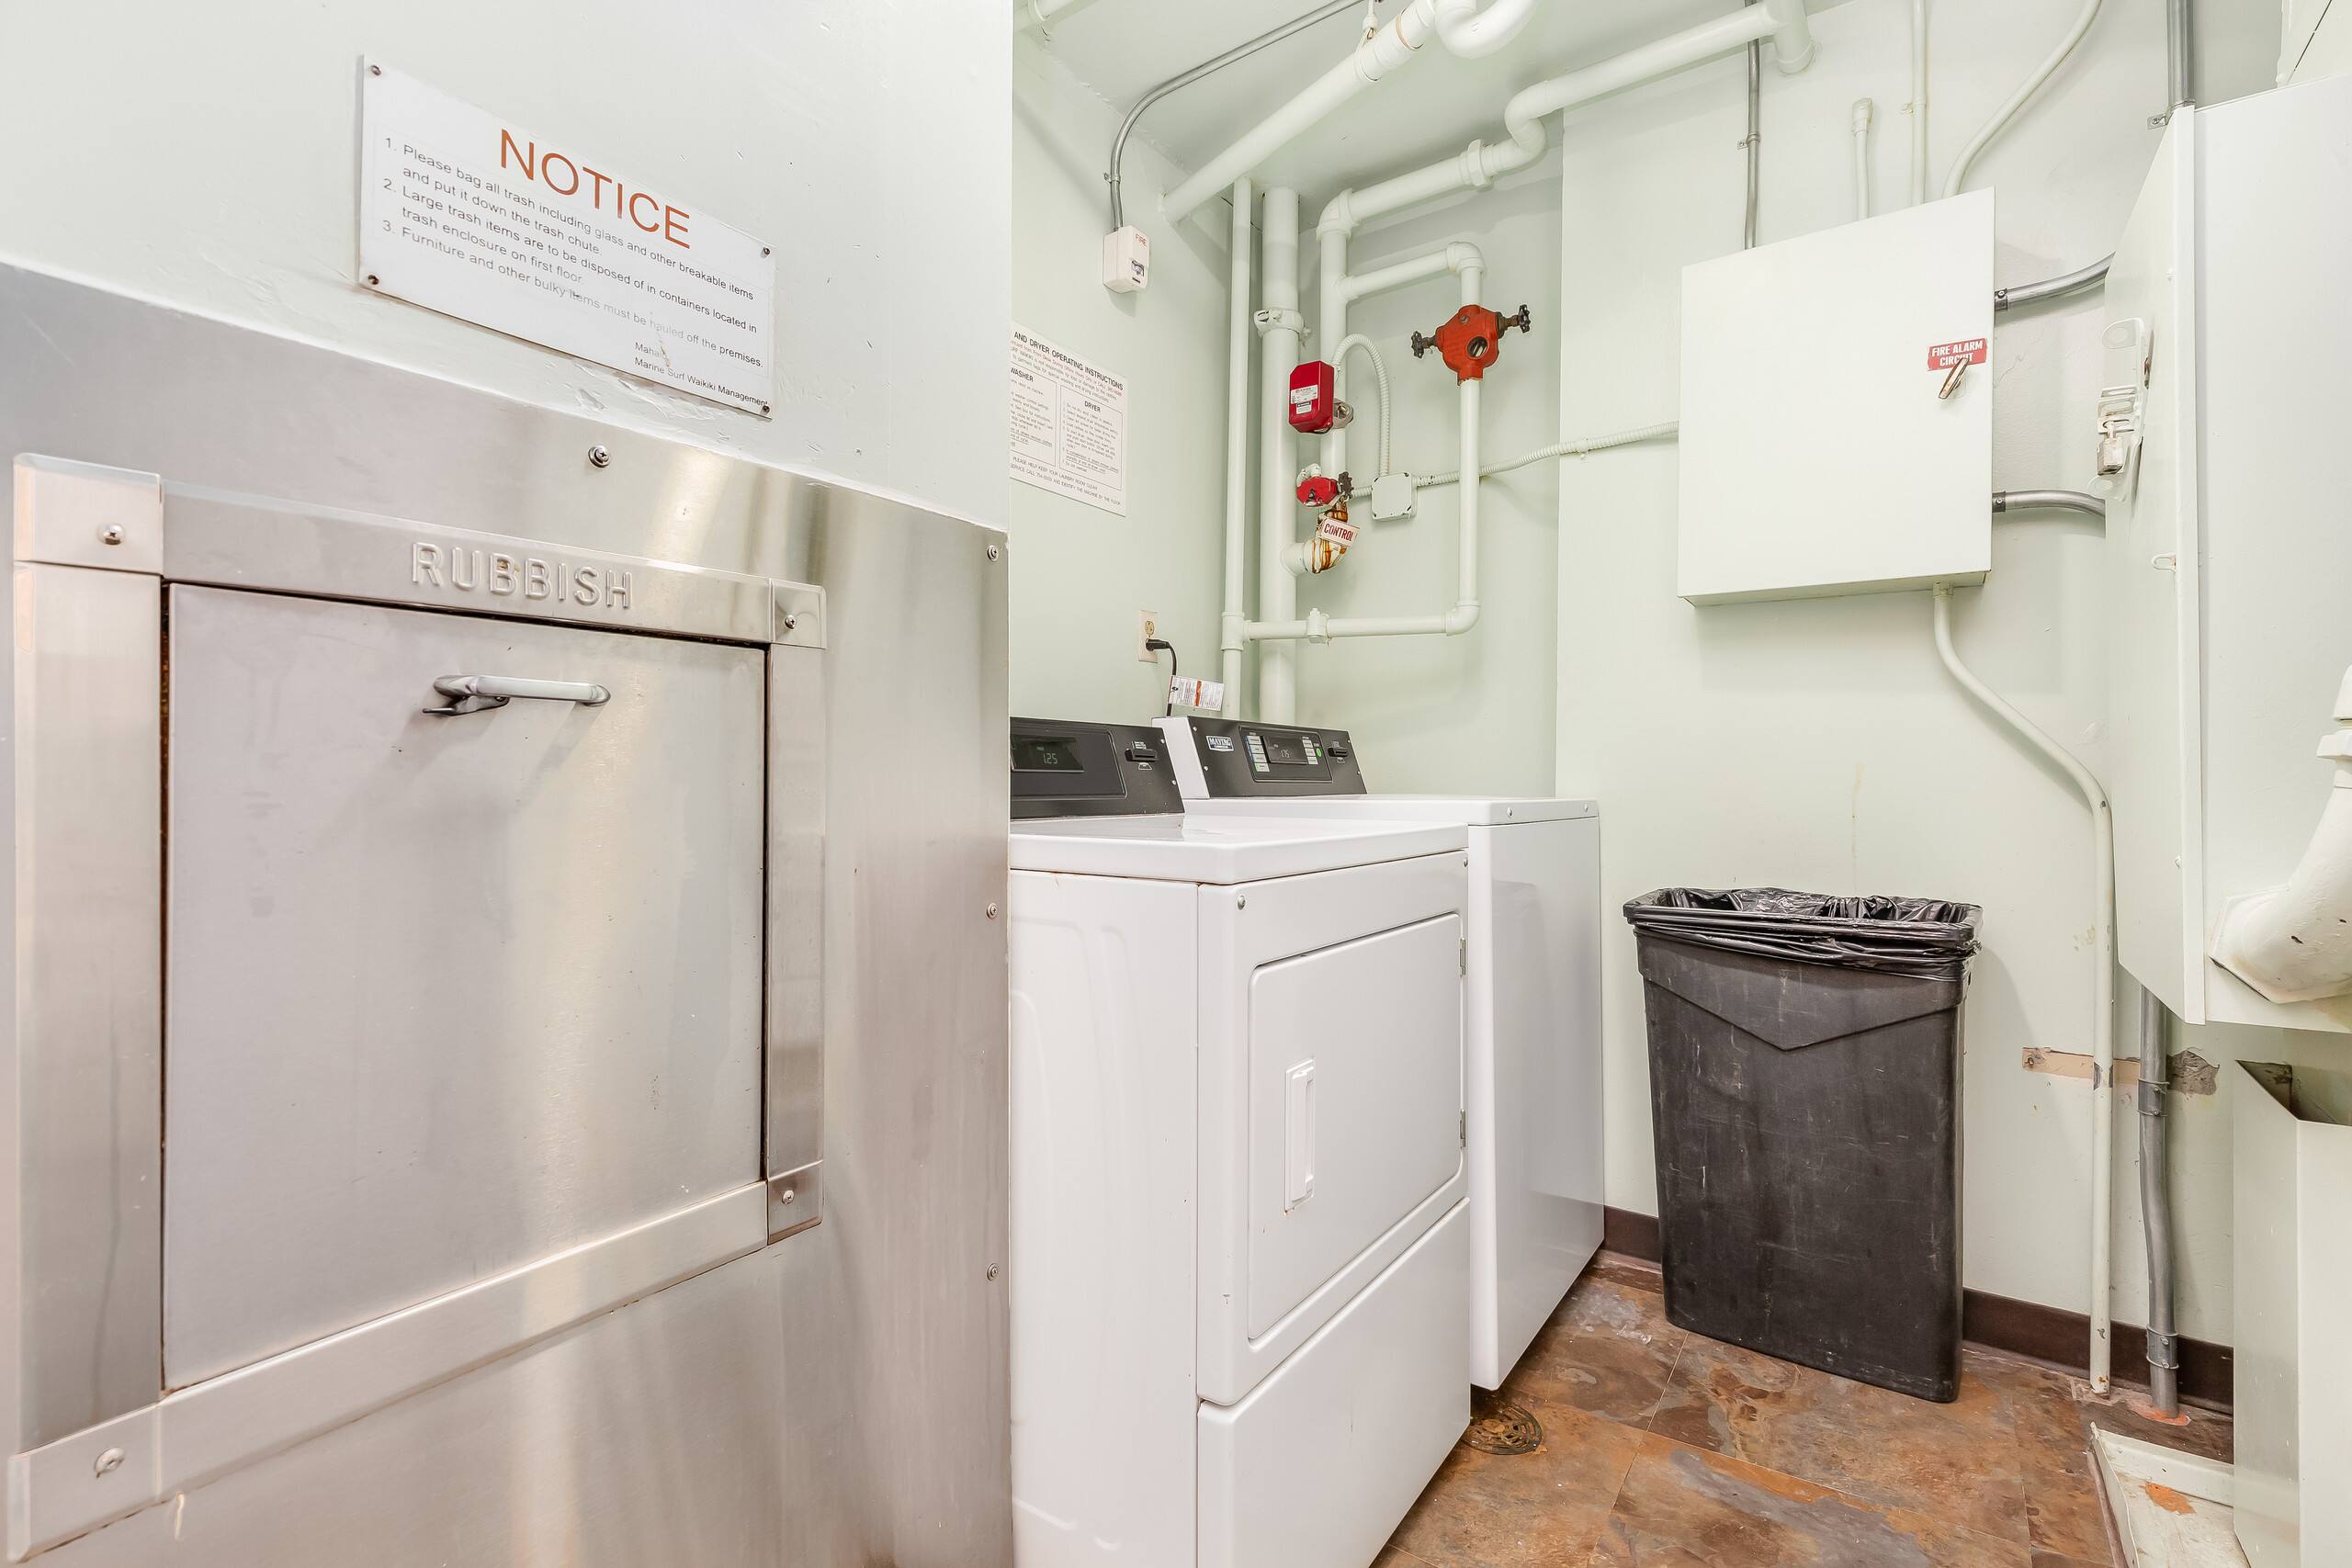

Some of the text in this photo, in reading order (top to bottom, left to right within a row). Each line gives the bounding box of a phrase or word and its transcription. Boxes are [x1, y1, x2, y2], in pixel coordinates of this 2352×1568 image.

[386, 137, 753, 300] 1. Please bag all trash including glass and other breakable items
[402, 167, 603, 256] and put it down the trash chute.
[501, 128, 691, 250] NOTICE
[383, 178, 757, 333] 2. Large trash items are to be disposed of in containers located in
[402, 207, 585, 286] trash enclosure on first floor.
[382, 220, 763, 368] 3. Furniture and other bulky items must be hauled off the premises.
[635, 342, 667, 359] Maha
[635, 357, 665, 374] Marine
[668, 368, 685, 381] Surf
[687, 374, 716, 390] Waikiki
[1014, 332, 1027, 343] AND
[1029, 339, 1049, 354] DRYER
[1052, 350, 1083, 370] OPERATING
[1085, 367, 1123, 390] INSTRUCTIONS
[1932, 341, 1983, 356] FIRE ALARM
[1085, 400, 1101, 412] DRYER
[1324, 523, 1354, 542] CONTROL
[412, 542, 633, 610] RUBBISH
